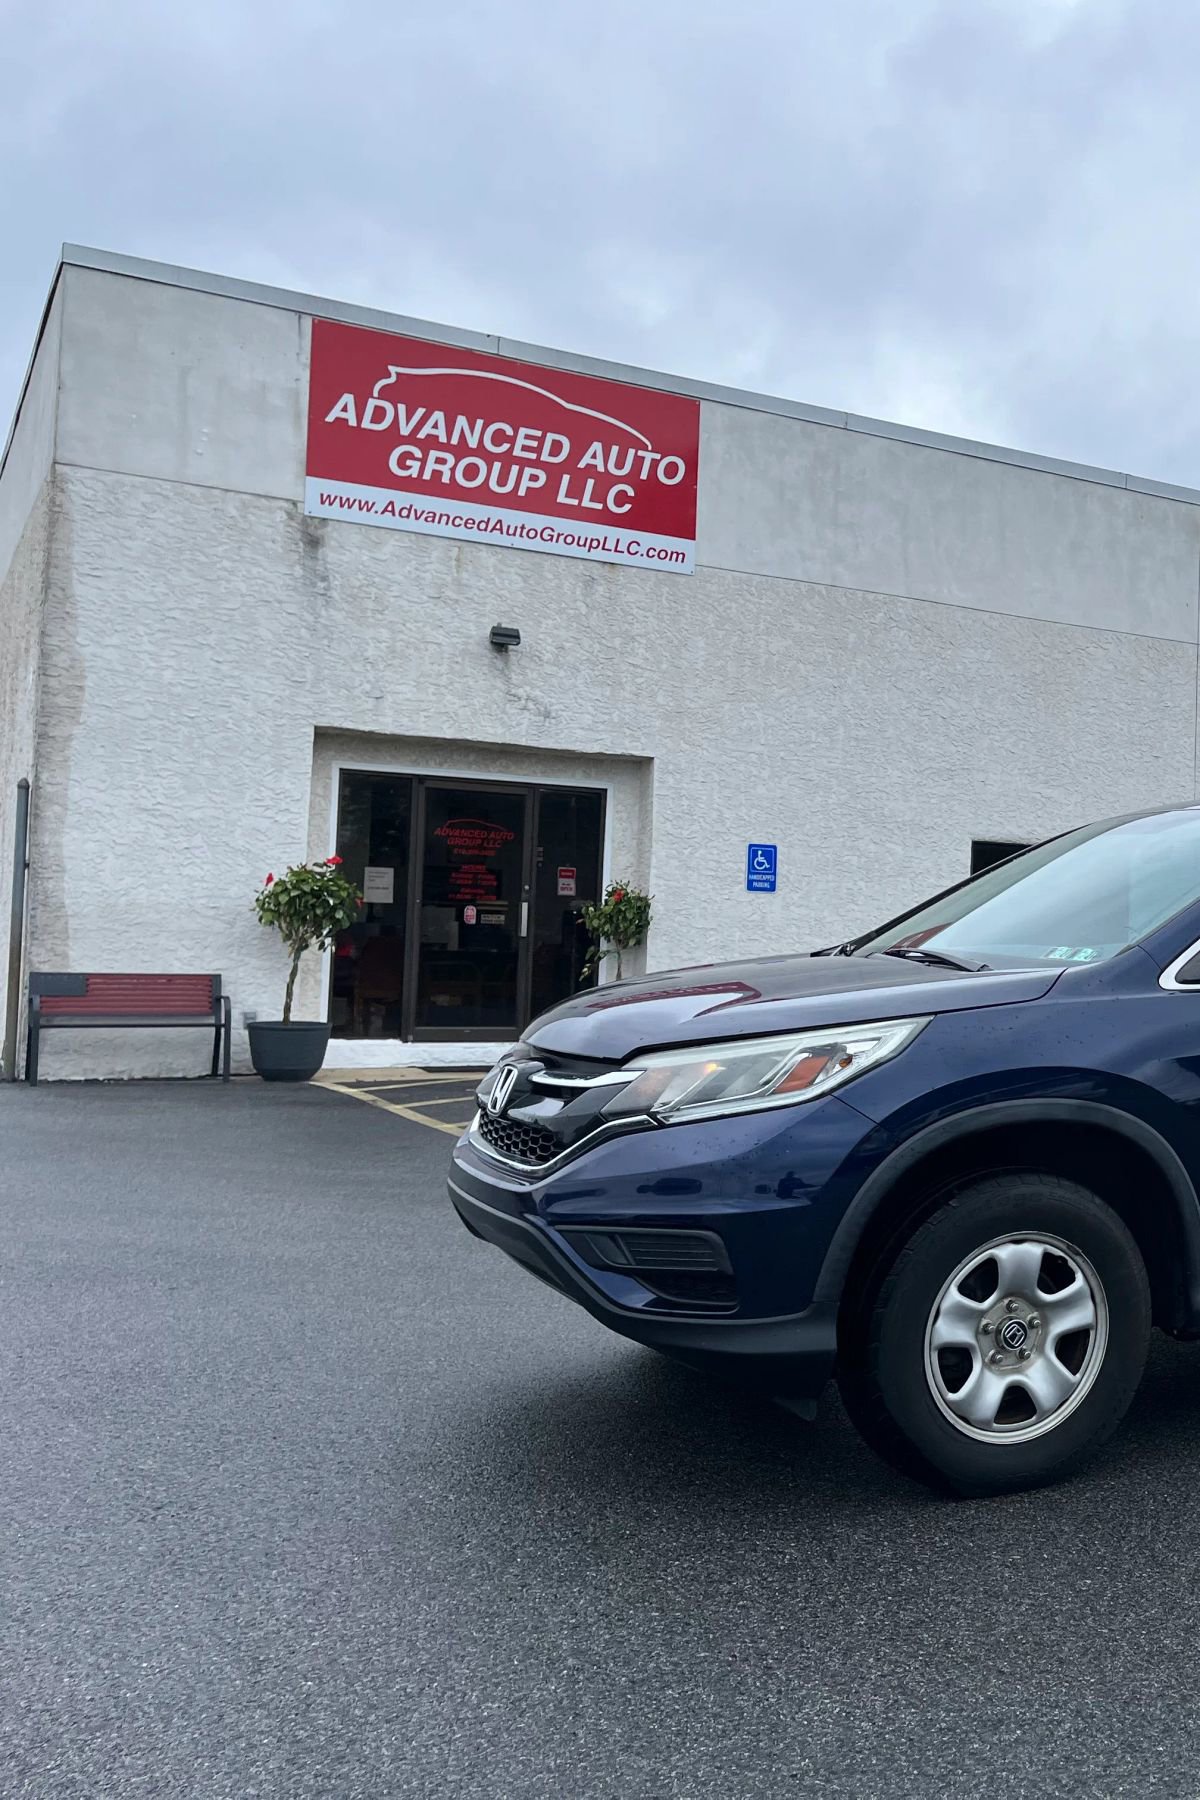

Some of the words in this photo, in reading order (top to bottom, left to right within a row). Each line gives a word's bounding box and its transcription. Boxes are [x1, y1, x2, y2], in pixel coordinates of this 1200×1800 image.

[325, 393, 570, 463] ADVANCED
[577, 441, 686, 486] AUTO
[388, 445, 547, 497] GROUP
[556, 474, 635, 514] LLC
[319, 491, 686, 564] www.AdvancedAutoGroupLLC.com
[434, 827, 487, 838] ADVANCED
[487, 831, 515, 841] AUTO
[447, 837, 481, 846] GROUP
[483, 839, 501, 848] LLC
